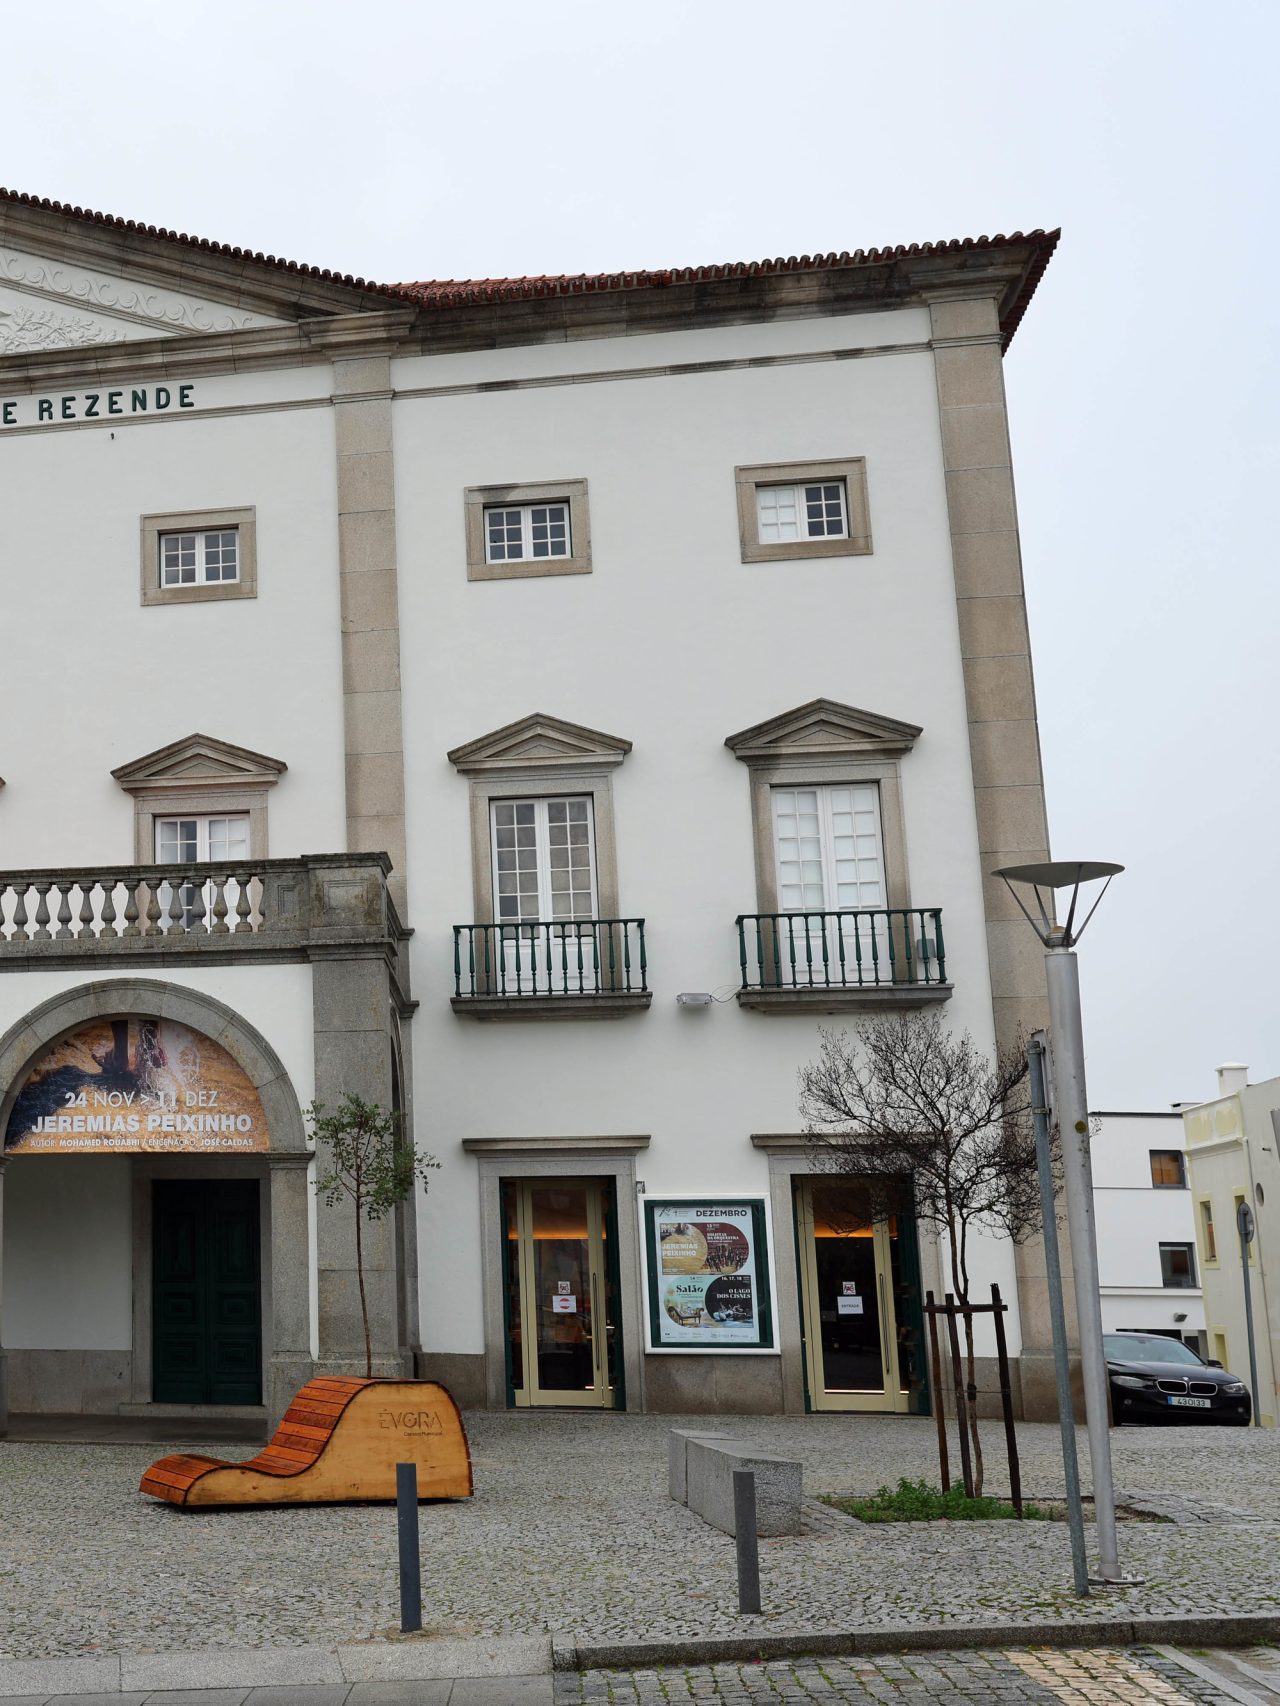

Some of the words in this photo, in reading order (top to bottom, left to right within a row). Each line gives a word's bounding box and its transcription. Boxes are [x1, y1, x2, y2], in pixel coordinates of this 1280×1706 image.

[38, 384, 196, 421] REZENDE
[64, 1091, 88, 1108] 24
[93, 1090, 136, 1108] NOV
[158, 1090, 178, 1107] 11
[185, 1090, 218, 1107] DEZ
[31, 1114, 140, 1134] JEREMIAS
[147, 1113, 253, 1133] PEIXINHO
[59, 1138, 101, 1147] MOHAMED
[222, 1138, 254, 1146] CALDAS
[696, 1209, 748, 1217] DEZEMBRO
[676, 1284, 704, 1293] Salão
